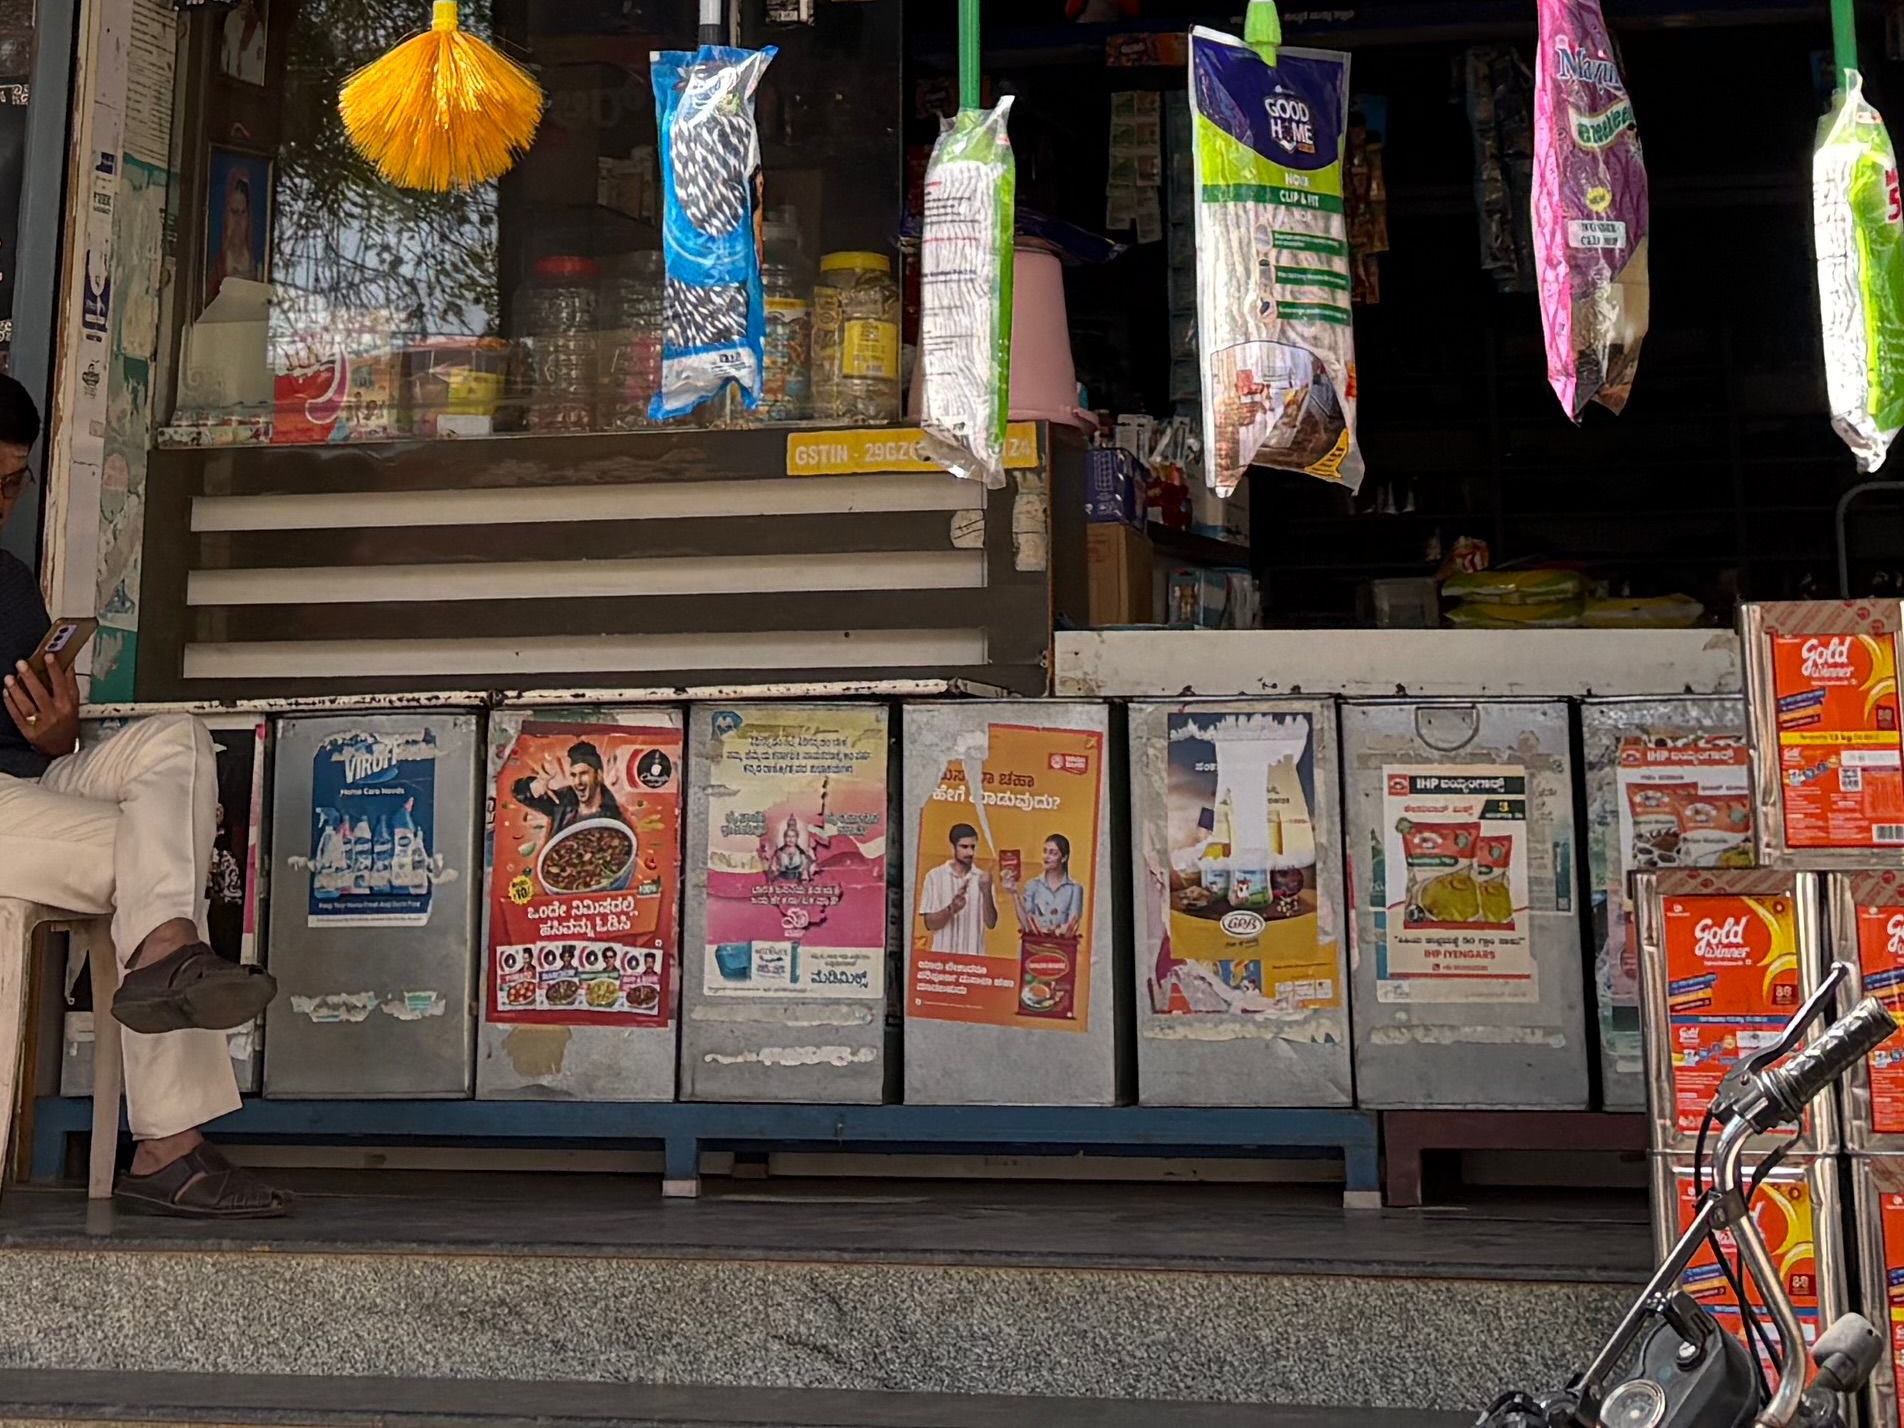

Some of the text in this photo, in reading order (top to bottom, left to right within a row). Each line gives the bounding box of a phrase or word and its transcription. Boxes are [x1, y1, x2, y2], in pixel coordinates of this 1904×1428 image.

[1264, 96, 1310, 123] GOOD
[1279, 190, 1320, 208] CLIP FIT
[795, 444, 847, 466] GSTIN
[1801, 635, 1851, 678] Gold
[1647, 748, 1669, 762] IHP
[1415, 777, 1439, 790] IHP
[1695, 914, 1749, 957] Gold
